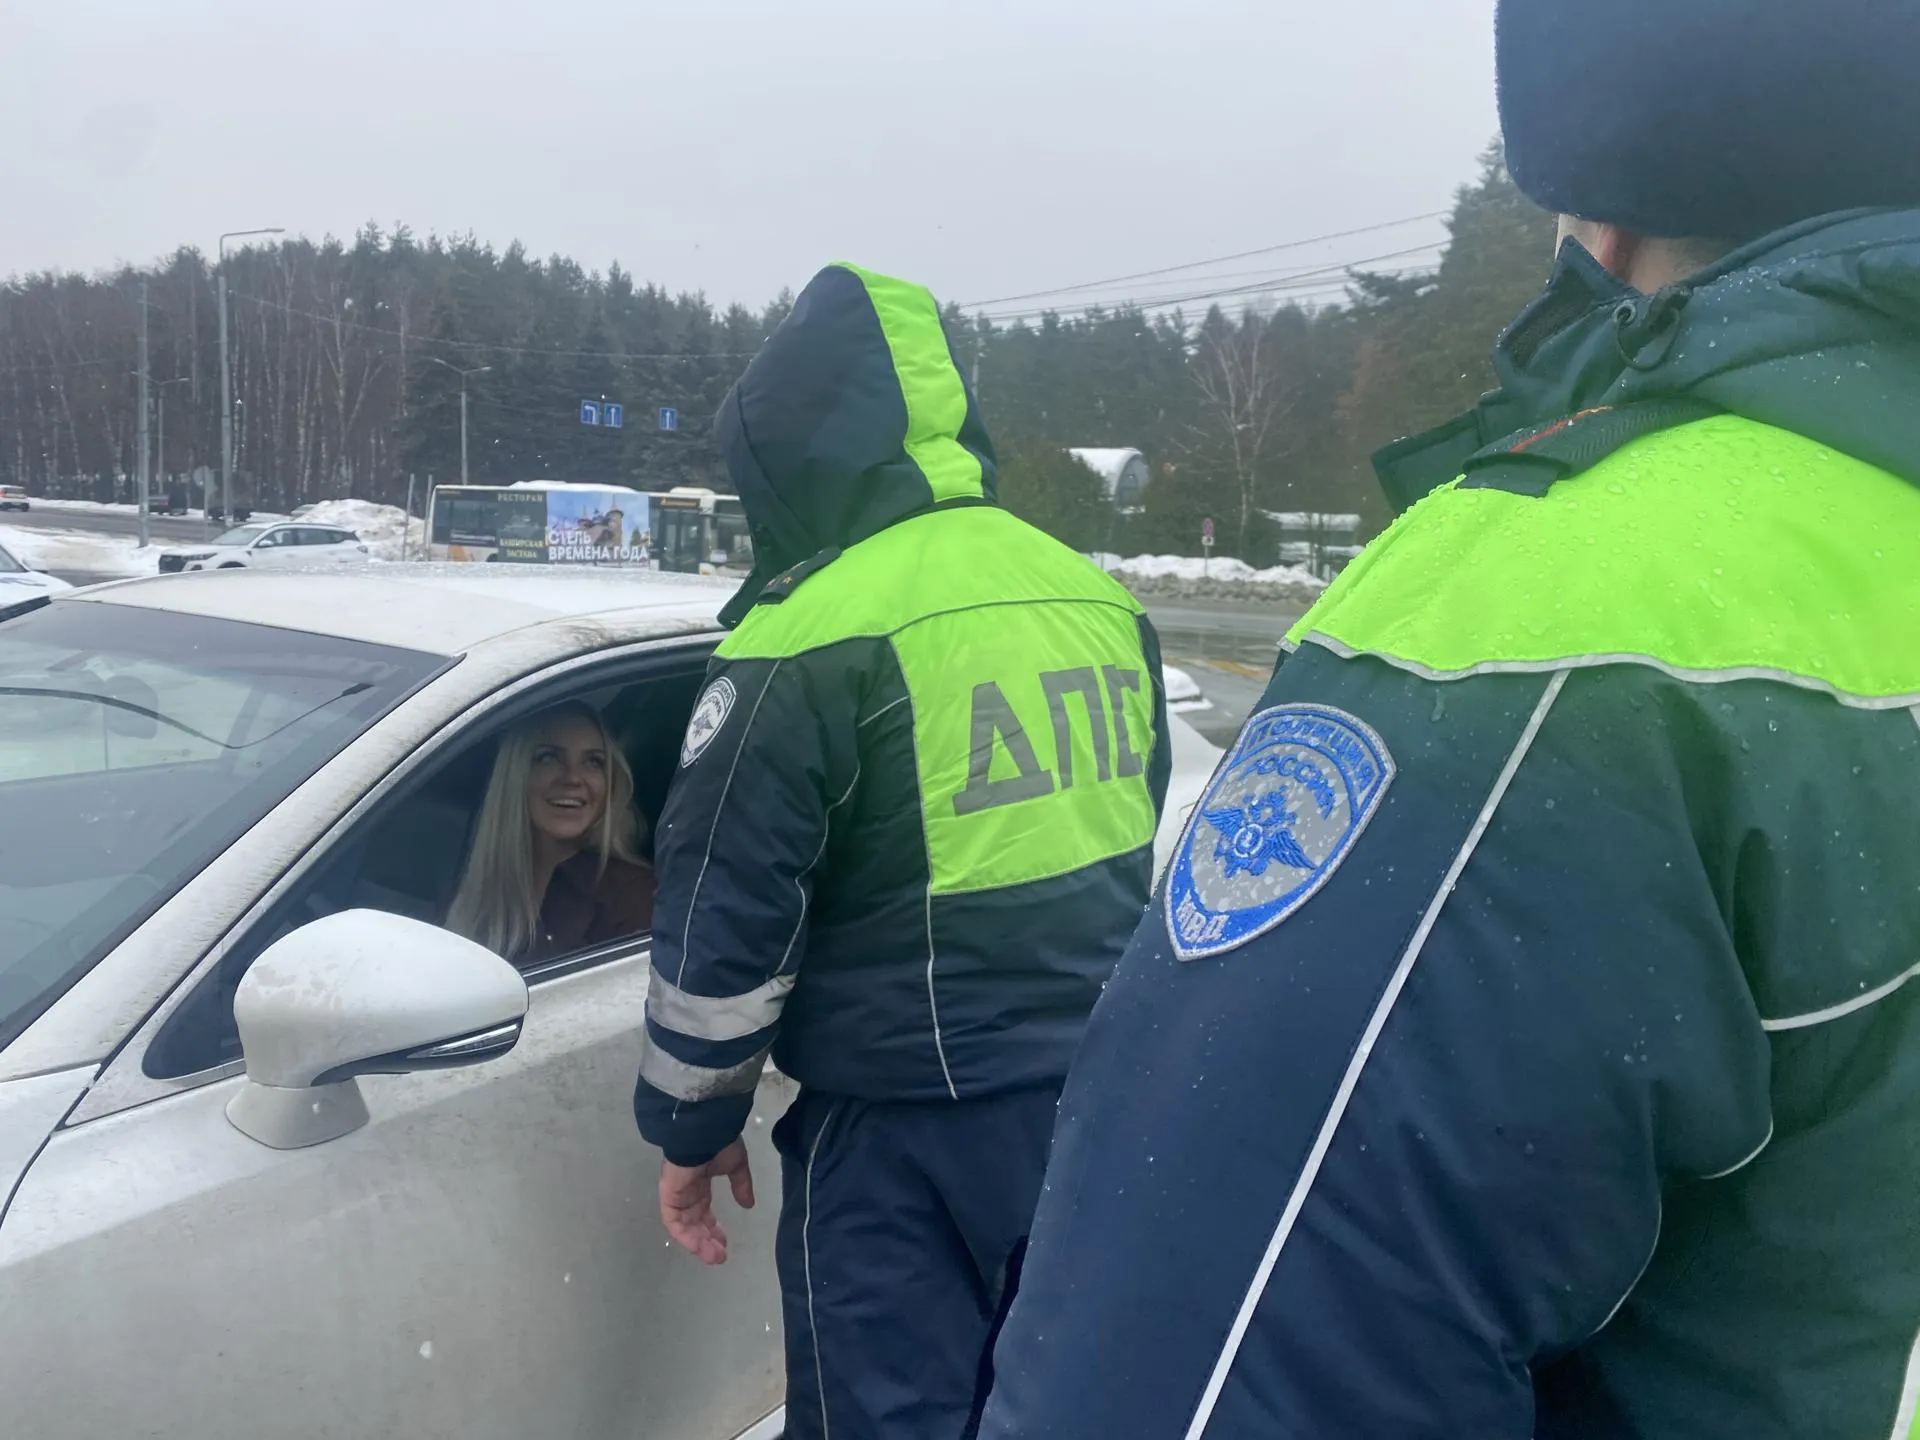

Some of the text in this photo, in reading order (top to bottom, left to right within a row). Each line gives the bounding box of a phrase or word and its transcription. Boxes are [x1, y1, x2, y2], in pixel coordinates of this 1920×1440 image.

[548, 546, 649, 562] ВРЕМЕНА ГОДА
[952, 664, 1144, 817] ДПС
